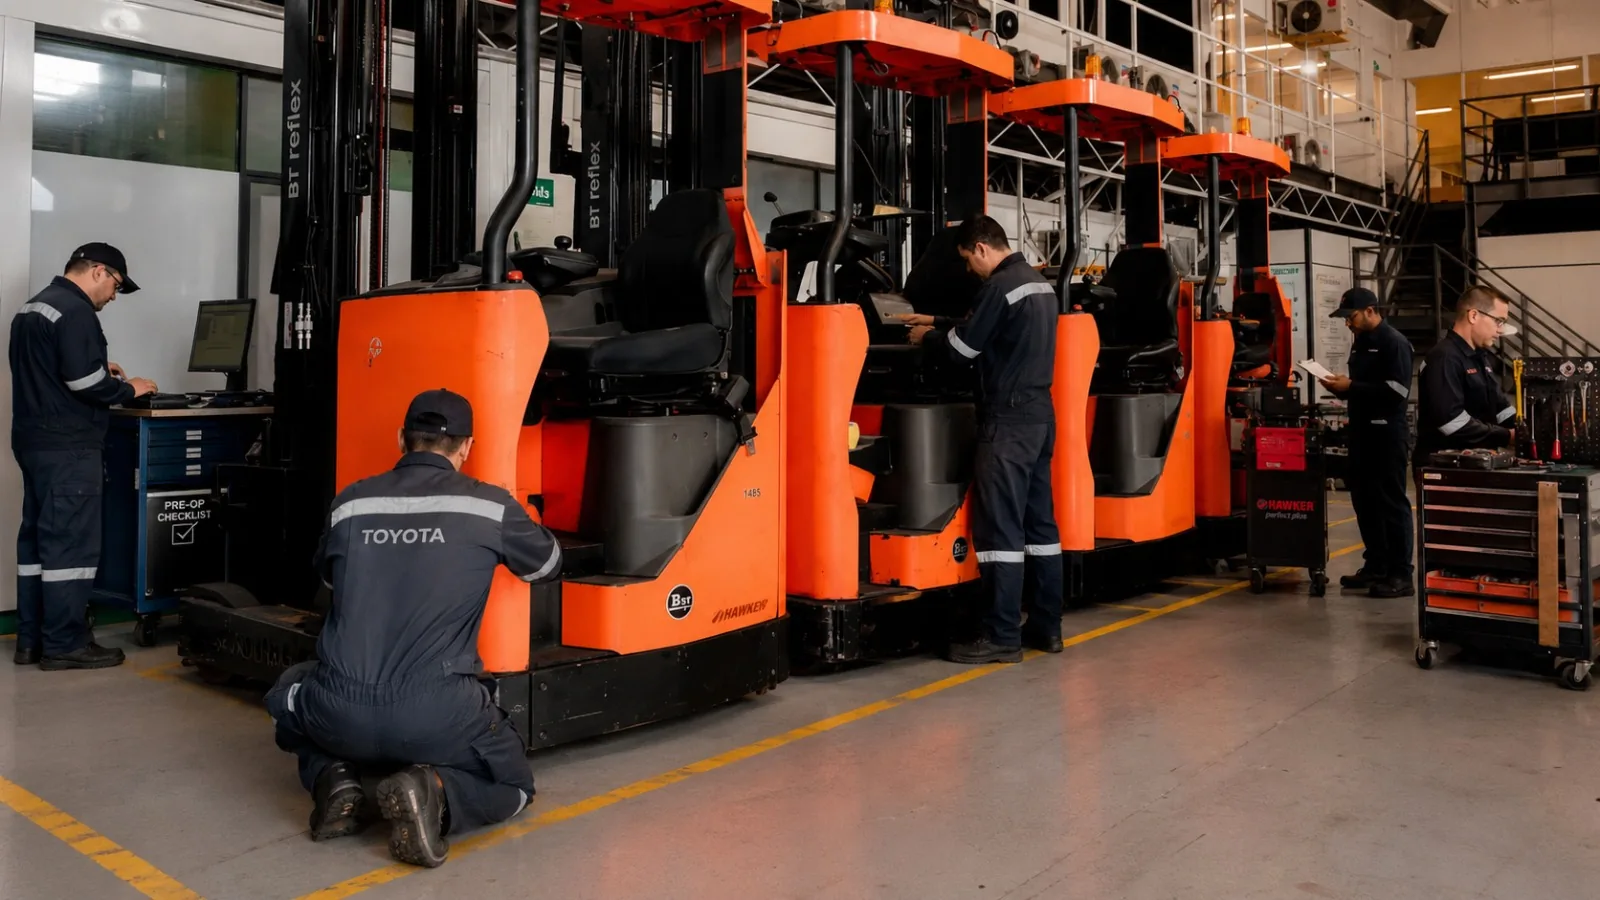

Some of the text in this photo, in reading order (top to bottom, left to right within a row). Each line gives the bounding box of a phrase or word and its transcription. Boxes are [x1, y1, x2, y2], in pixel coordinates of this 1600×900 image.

[287, 78, 302, 199] BT reflex
[587, 140, 601, 229] BT reflex
[164, 499, 205, 511] PRE-OP
[1268, 500, 1315, 511] HAWKER
[157, 510, 211, 522] CHECKLIST
[361, 527, 446, 545] TOYOTA
